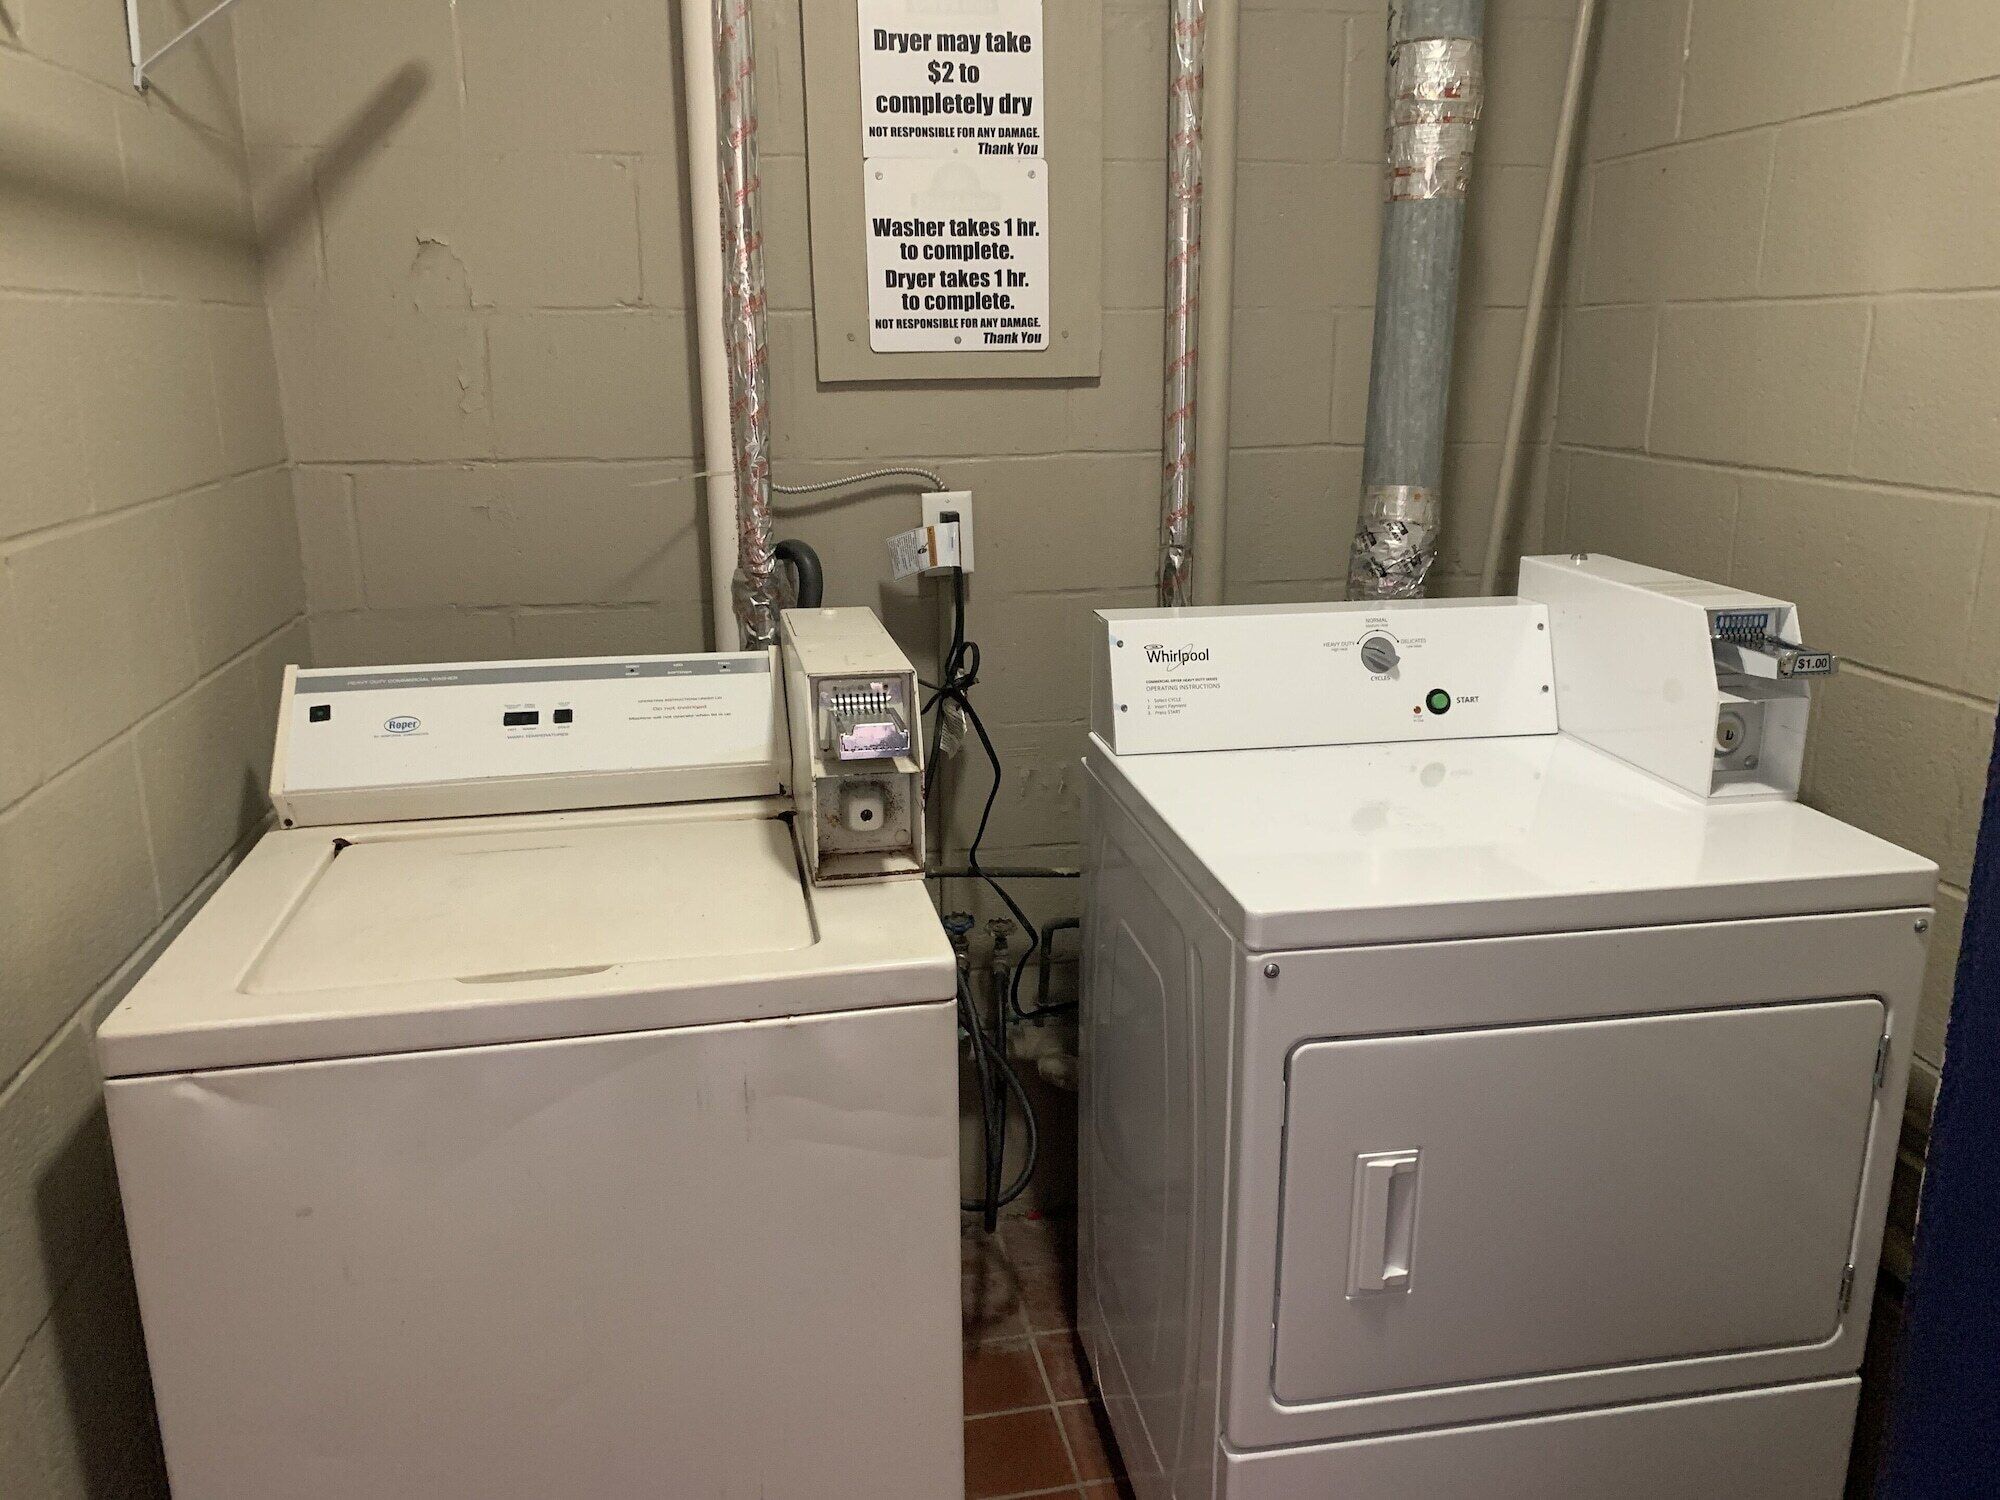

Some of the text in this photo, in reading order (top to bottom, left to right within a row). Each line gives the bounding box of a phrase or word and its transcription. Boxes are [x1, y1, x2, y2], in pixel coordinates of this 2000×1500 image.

[873, 28, 1032, 54] Dryer may take
[927, 59, 980, 84] $2 to
[876, 92, 1033, 116] completely dry
[868, 126, 1040, 138] NOT RESPONSIBLE FOR ANY DAMAGE.
[978, 142, 1038, 155] Thank You
[872, 218, 1040, 237] Washer takes 1 hr.
[900, 242, 1014, 262] to complete.
[885, 269, 1029, 290] Dryer takes 1 hr.
[902, 292, 1015, 312] to complete.
[875, 317, 1041, 329] NOT RESPONSIBLE FOR ANY DAMAGE.
[983, 332, 1042, 344] Thank You
[727, 366, 735, 424] PRESSURE
[1146, 648, 1210, 666] Whirlpool
[1797, 658, 1828, 670] $1.00
[1456, 696, 1479, 704] START
[389, 720, 417, 730] Roper
